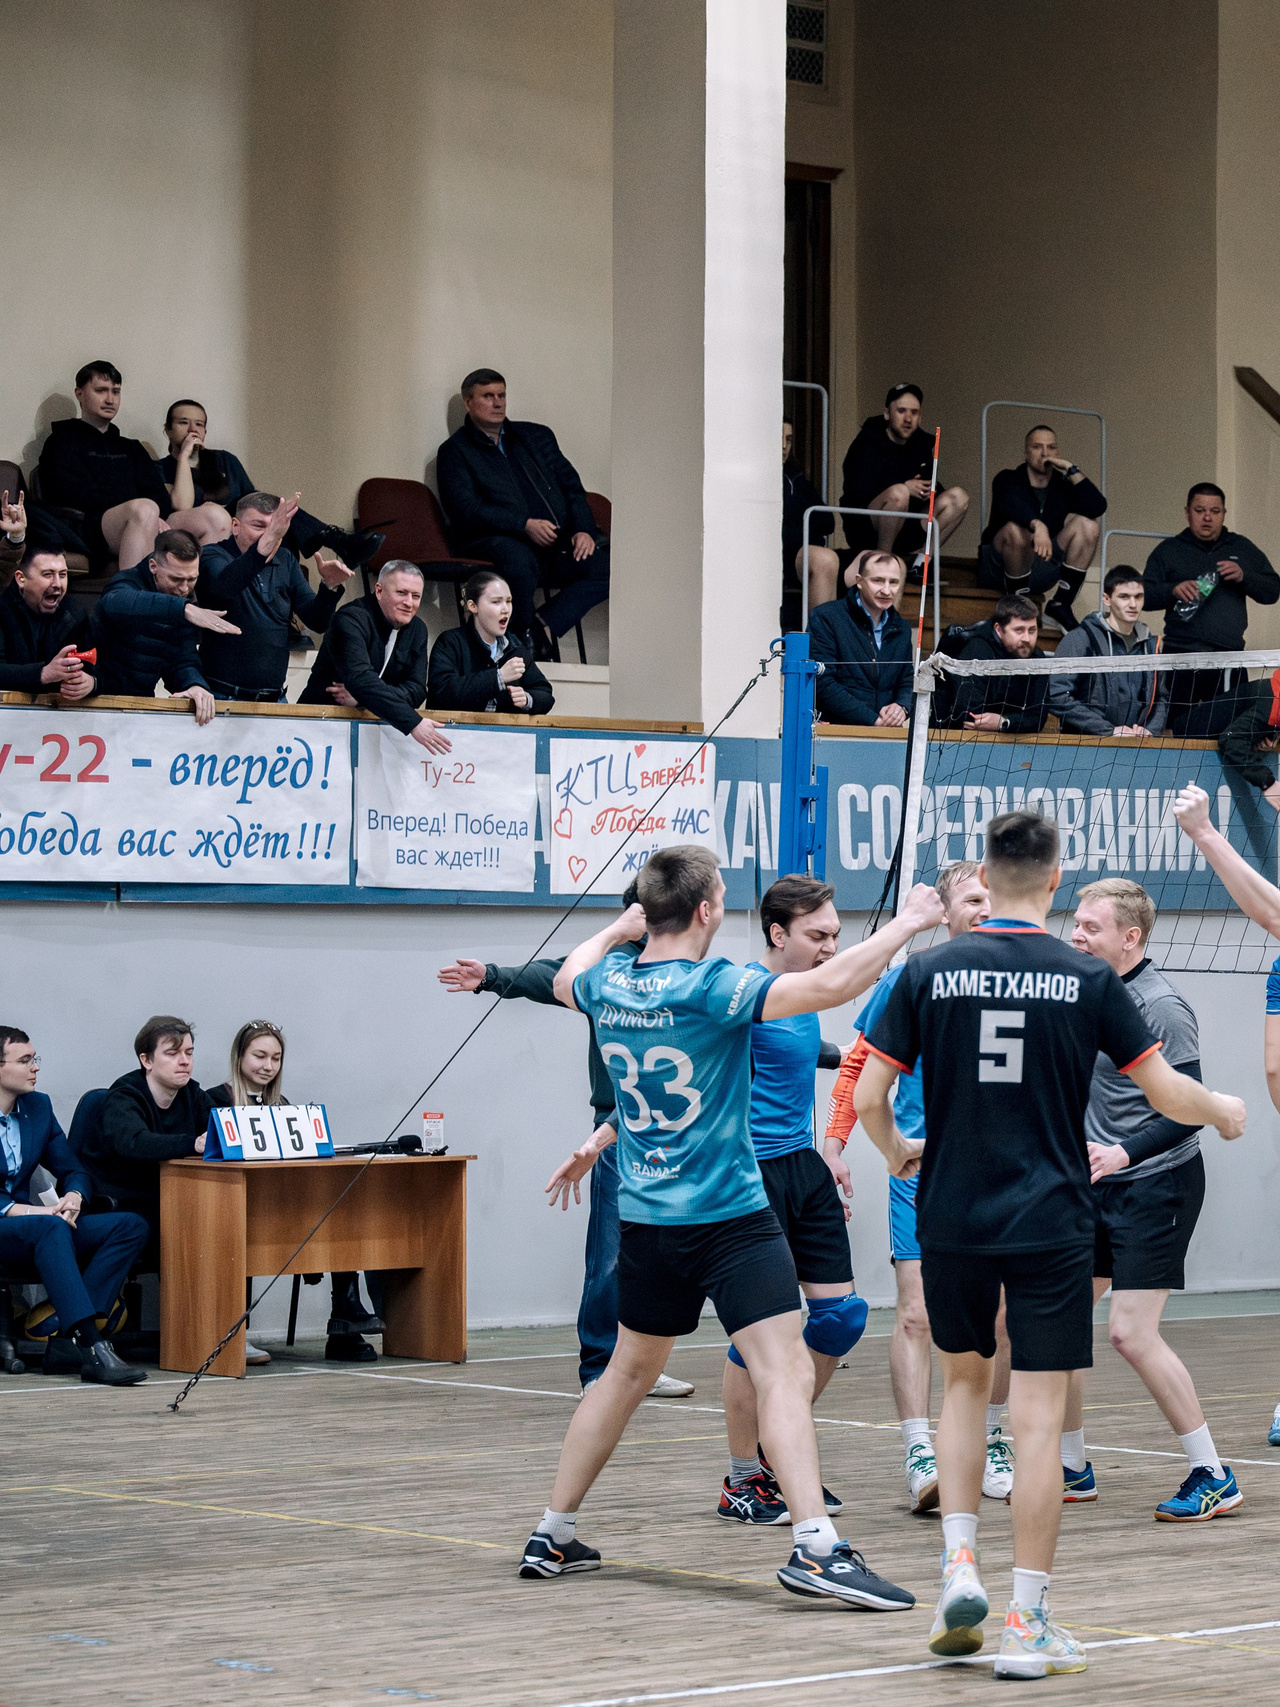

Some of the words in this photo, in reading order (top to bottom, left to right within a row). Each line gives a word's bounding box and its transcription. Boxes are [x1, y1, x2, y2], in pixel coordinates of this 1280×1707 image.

[169, 737, 333, 804] вперёд!
[420, 760, 476, 789] Ту-22
[556, 752, 638, 813] КТЦ
[367, 809, 447, 838] Вперед!
[455, 812, 529, 840] Победа
[671, 807, 710, 835] НАС
[0, 811, 103, 856] обеда
[117, 828, 177, 857] вас
[188, 815, 337, 868] ждёт!!!
[396, 848, 428, 865] вас
[434, 847, 500, 871] ждет!!!
[931, 969, 1080, 1003] АХМЕТХАНОВ
[598, 1003, 675, 1030] ДИМОН
[978, 1009, 1026, 1083] 5
[600, 1042, 702, 1132] 33
[224, 1120, 237, 1142] 0
[248, 1117, 267, 1152] 5
[285, 1117, 304, 1152] 5
[313, 1117, 324, 1139] 0
